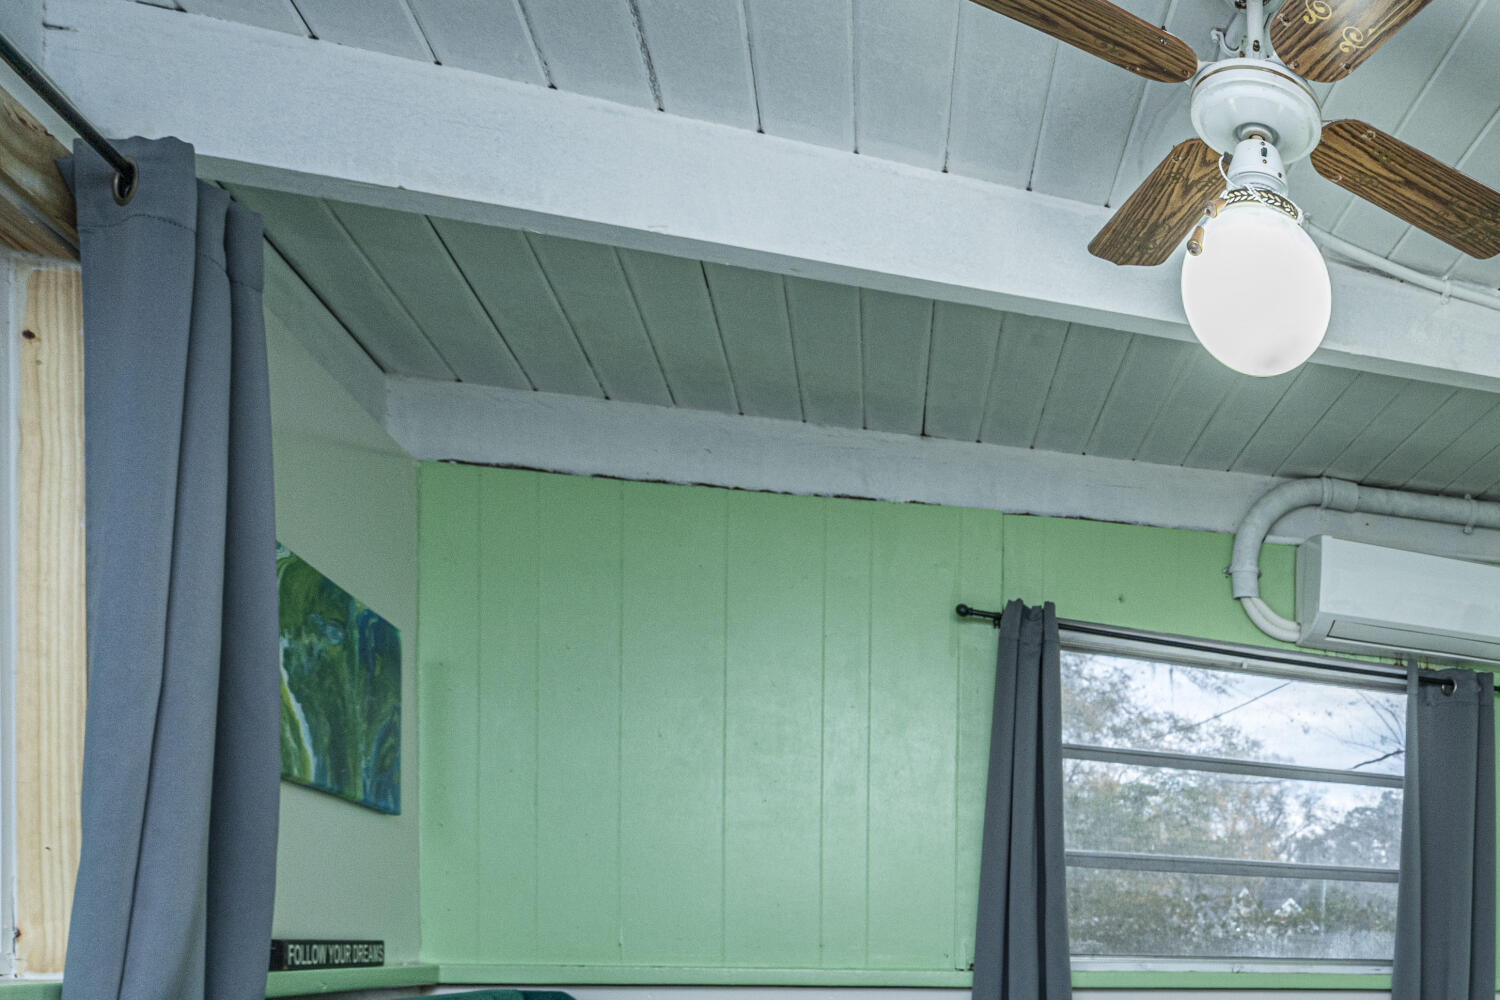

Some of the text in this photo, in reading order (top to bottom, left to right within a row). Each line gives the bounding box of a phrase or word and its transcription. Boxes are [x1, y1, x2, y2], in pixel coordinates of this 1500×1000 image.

[287, 943, 384, 966] FOLLOW YOUR DREAMS
